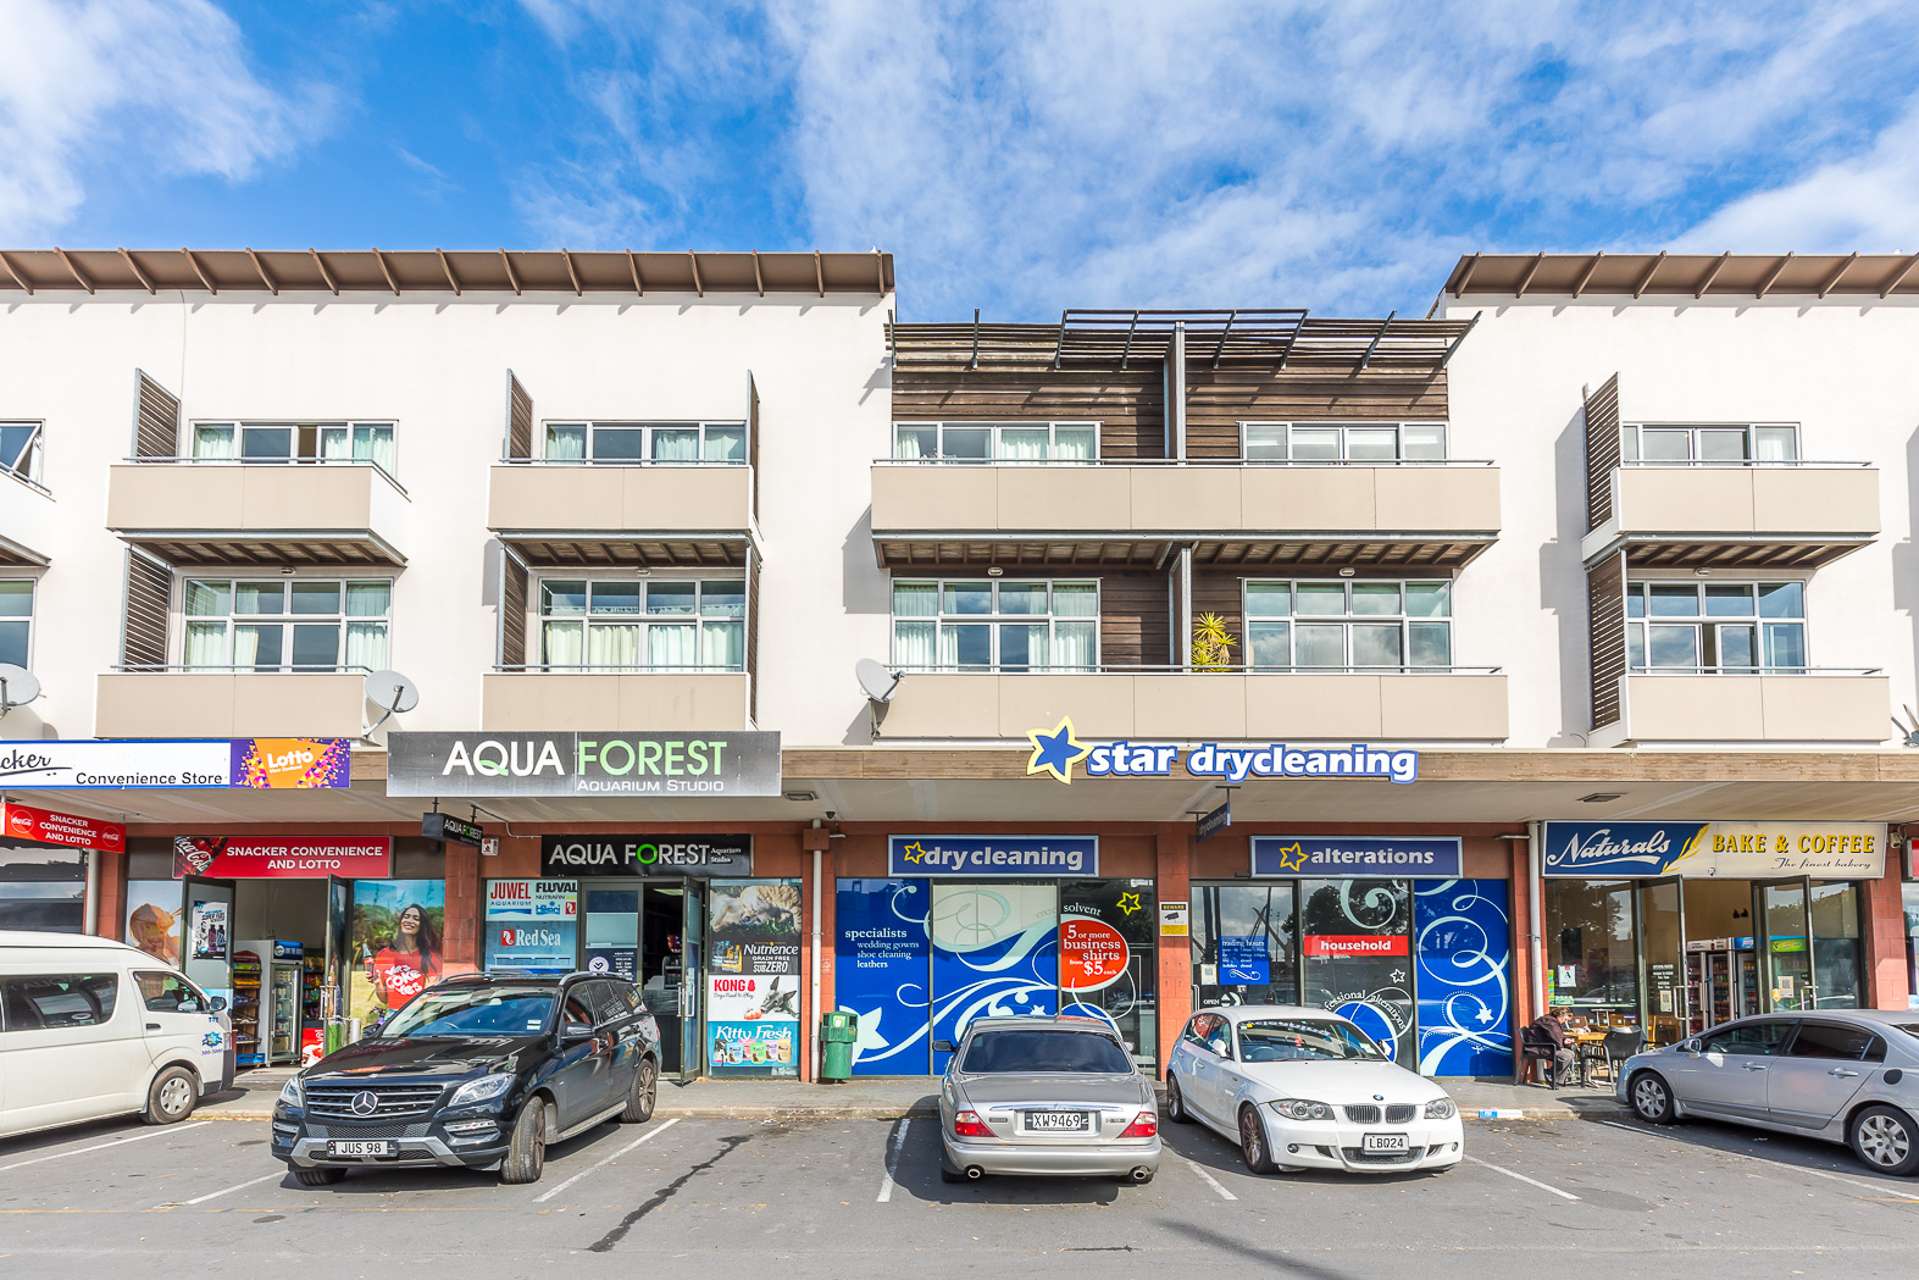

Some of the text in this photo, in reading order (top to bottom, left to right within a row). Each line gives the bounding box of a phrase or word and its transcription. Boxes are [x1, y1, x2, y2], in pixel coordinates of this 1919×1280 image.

[267, 750, 314, 769] Lotto
[442, 740, 728, 777] AQUA FOREST
[1088, 741, 1419, 784] star drycleaning
[76, 772, 223, 785] Convenience Store
[50, 814, 89, 827] SNACKER
[39, 822, 97, 838] CONVENIENCE
[444, 819, 483, 840] AQUA FOREST
[45, 832, 92, 845] AND LOTTO
[1712, 834, 1875, 853] BAKE & COFFEE
[226, 846, 383, 857] SNACKER CONVENIENCE
[548, 843, 710, 865] AQUA FOREST
[1547, 829, 1671, 866] Naturals
[924, 847, 1083, 871] dry cleaning
[1311, 847, 1435, 864] alterations
[267, 860, 341, 869] AND LOTTO
[1774, 858, 1796, 869] The
[1799, 858, 1831, 869] finest
[491, 882, 532, 899] JUWEL
[536, 882, 578, 893] FLUVAL
[1063, 902, 1102, 916] solvent
[516, 929, 560, 946] Red Sea
[845, 928, 907, 941] specialists
[1068, 925, 1077, 939] 5
[744, 942, 798, 955] Nutrience
[857, 940, 919, 950] wedding gowns
[1064, 938, 1121, 949] business
[1320, 940, 1392, 950] household
[857, 950, 912, 960] shoe cleaning
[1082, 949, 1120, 961] shirts
[857, 960, 889, 968] leathers
[1084, 960, 1104, 976] $5
[386, 969, 423, 990] COKE
[714, 979, 746, 991] KONG
[1370, 994, 1407, 1030] alterations
[715, 1024, 792, 1040] Kitty Fresh
[1033, 1113, 1081, 1128] XW9469
[341, 1143, 382, 1153] JUS 98
